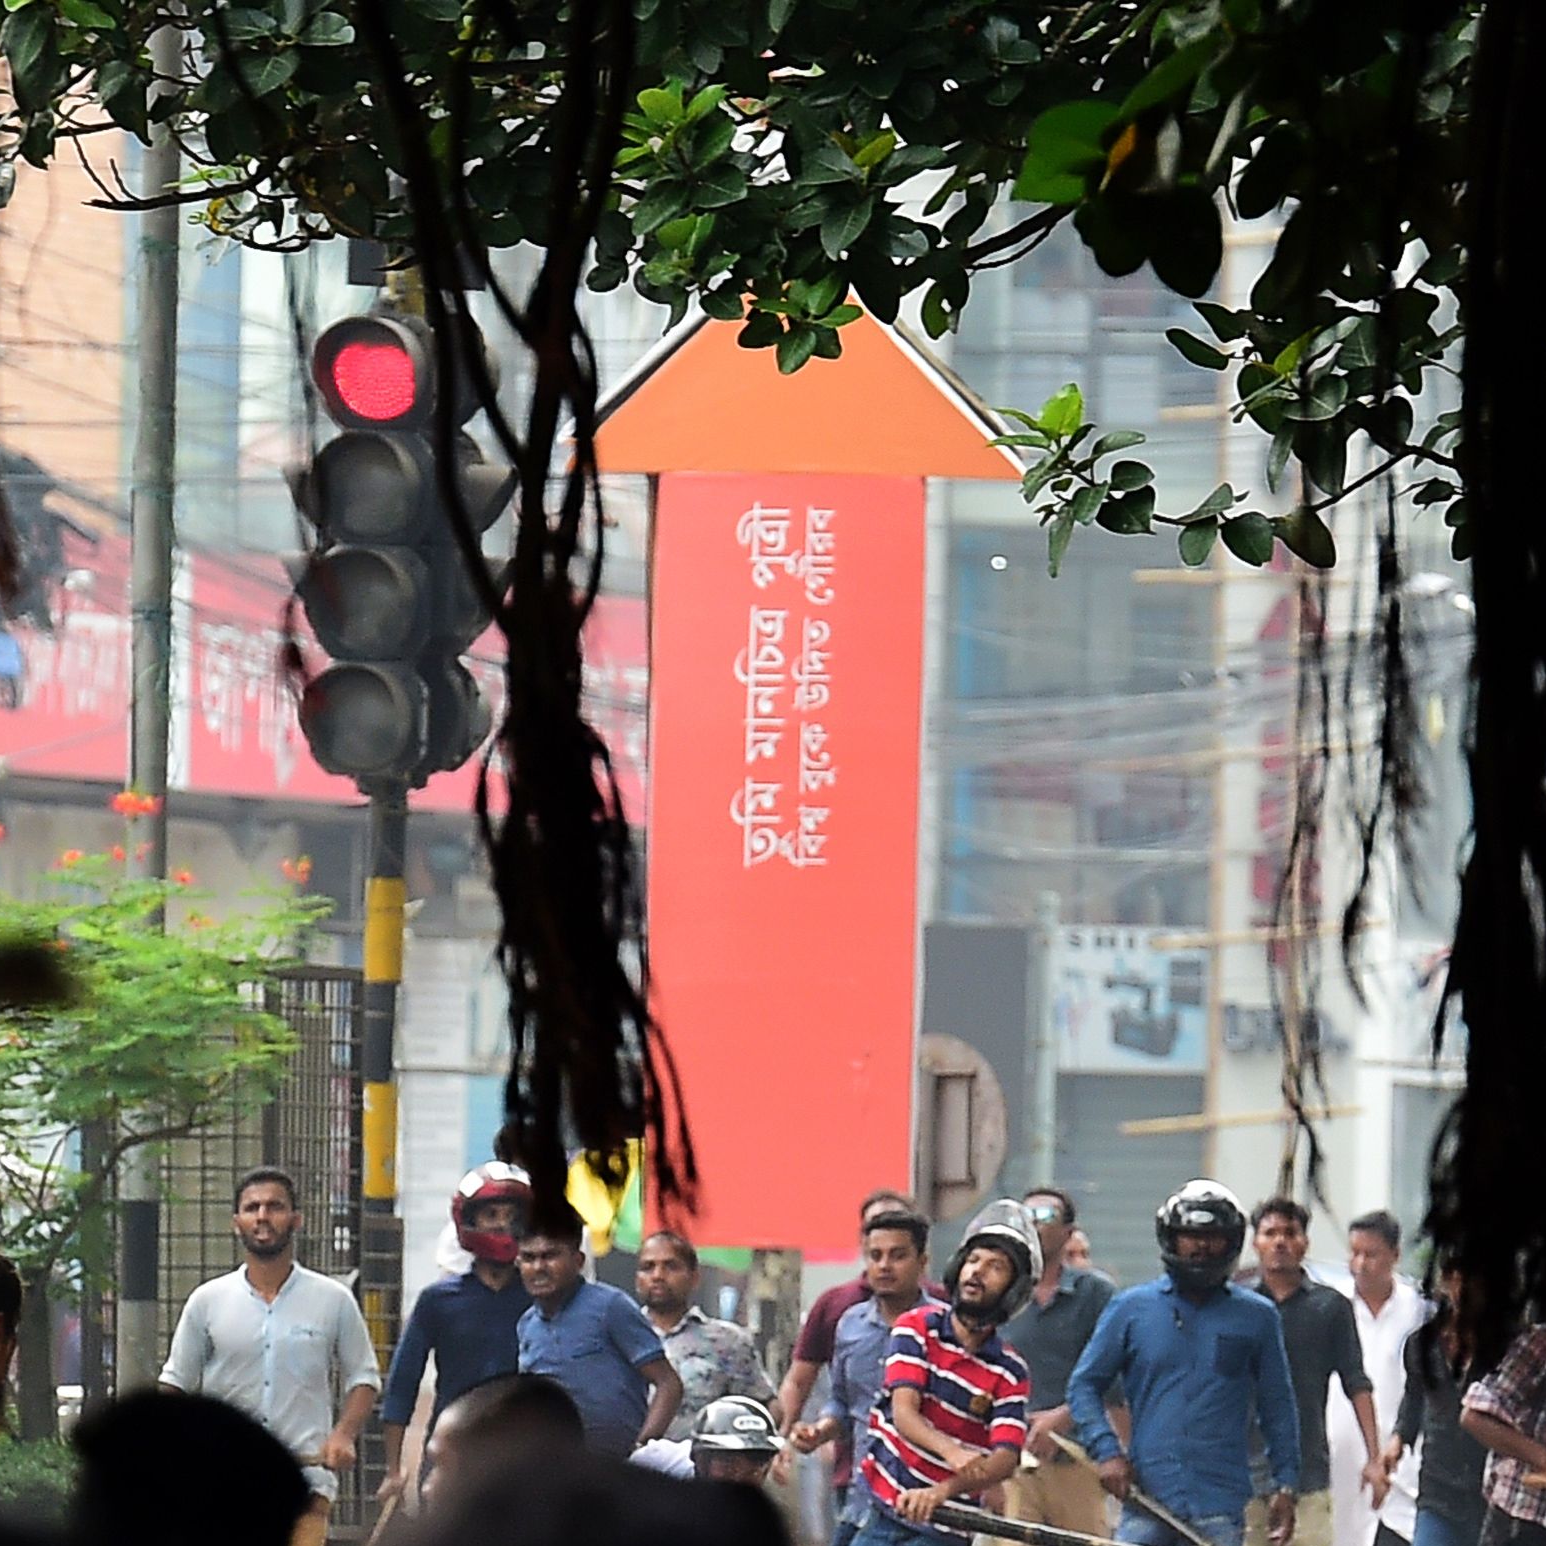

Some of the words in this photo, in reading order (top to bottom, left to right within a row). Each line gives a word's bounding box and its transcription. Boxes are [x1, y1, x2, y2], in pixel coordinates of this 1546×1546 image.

[797, 506, 835, 605] গৌরব
[734, 605, 788, 763] মানচিত্র
[791, 616, 832, 712] উদিত
[798, 721, 837, 793] বুকে
[729, 776, 794, 869] তুমি
